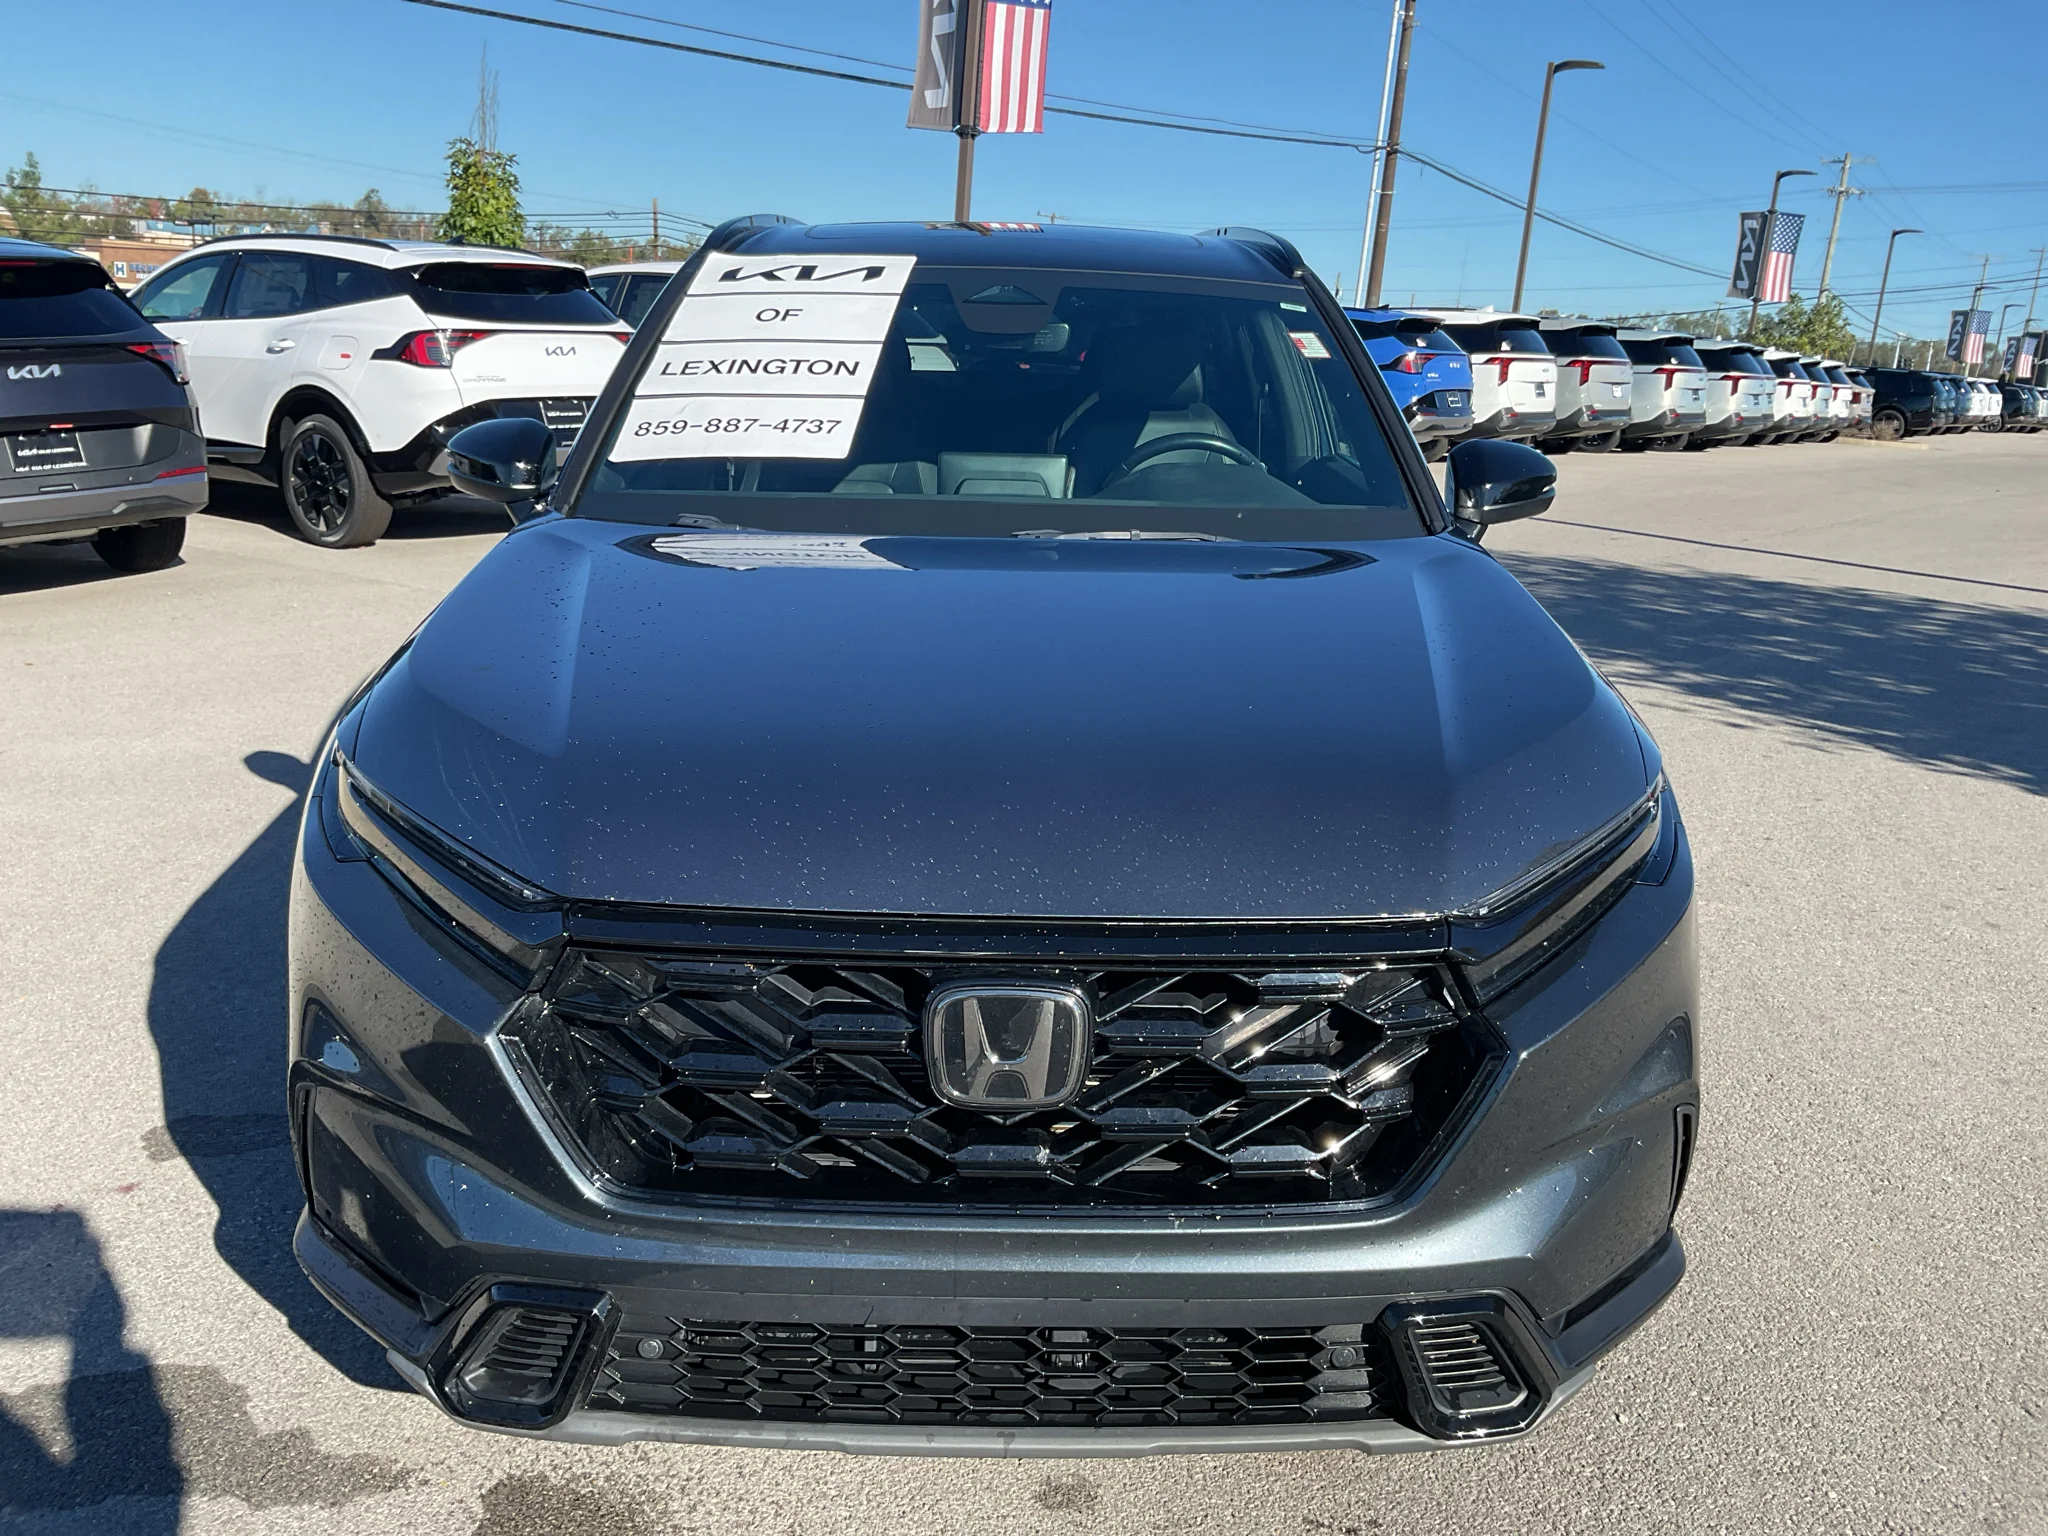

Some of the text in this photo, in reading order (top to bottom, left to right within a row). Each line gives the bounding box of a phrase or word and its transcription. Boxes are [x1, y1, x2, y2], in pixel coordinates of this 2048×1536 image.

[718, 264, 887, 282] KIA
[755, 308, 803, 322] OF
[545, 346, 577, 356] KIA
[7, 364, 62, 380] KIA
[660, 359, 860, 376] LEXINGTON
[633, 418, 842, 437] 859-887-4737
